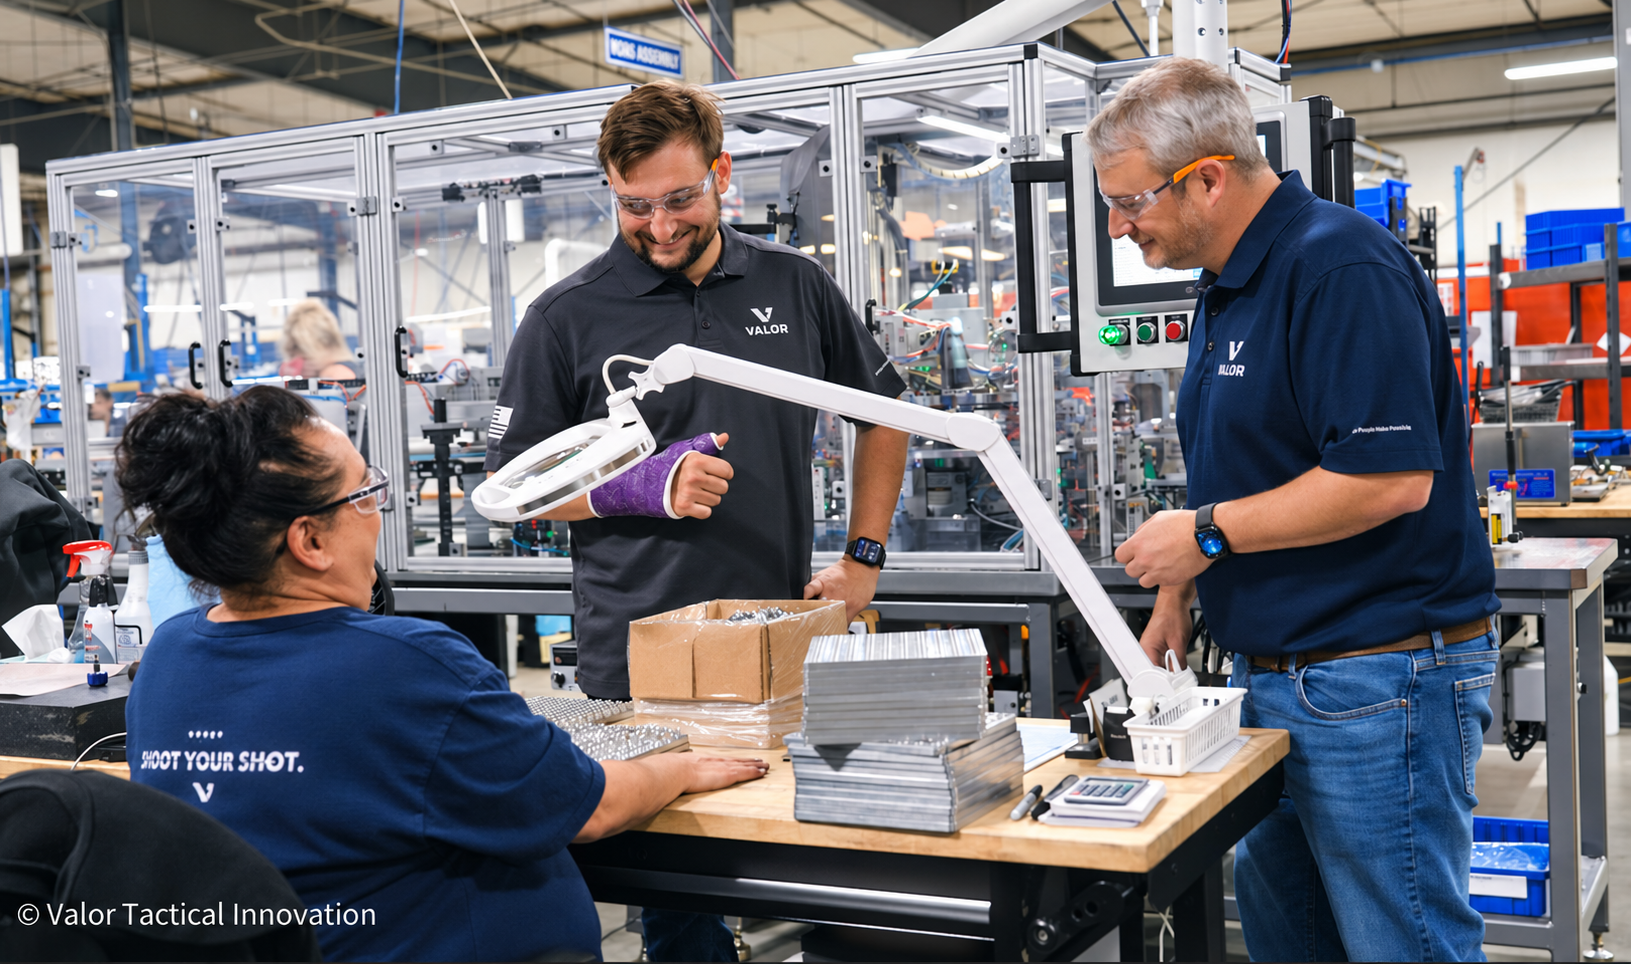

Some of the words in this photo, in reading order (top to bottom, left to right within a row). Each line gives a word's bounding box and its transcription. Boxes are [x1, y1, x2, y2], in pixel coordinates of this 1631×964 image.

[637, 44, 679, 70] ASSEMBLY
[744, 323, 789, 336] VALOR
[183, 750, 234, 772] YOUR
[237, 750, 304, 773] SHOT.
